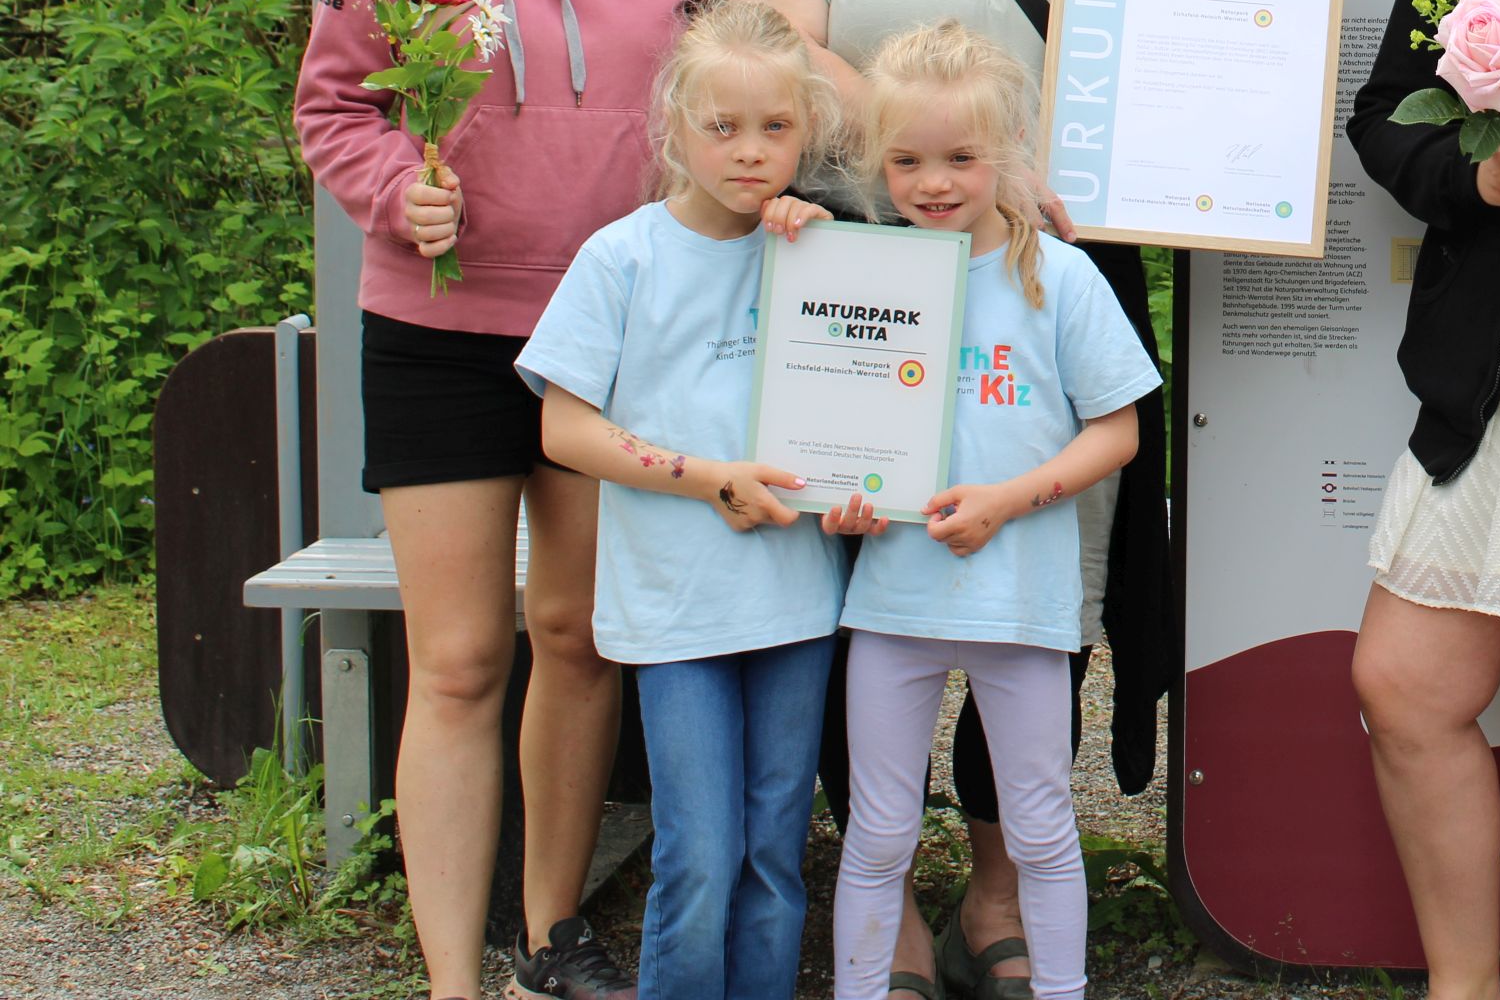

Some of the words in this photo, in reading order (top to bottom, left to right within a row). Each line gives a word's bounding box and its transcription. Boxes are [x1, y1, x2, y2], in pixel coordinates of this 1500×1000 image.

[802, 301, 920, 326] NATURPARK
[846, 324, 887, 341] KITA
[1222, 340, 1254, 348] führungen
[786, 363, 890, 379] Eichsfeld-Hainich-Werratal
[852, 360, 890, 369] Naturpark
